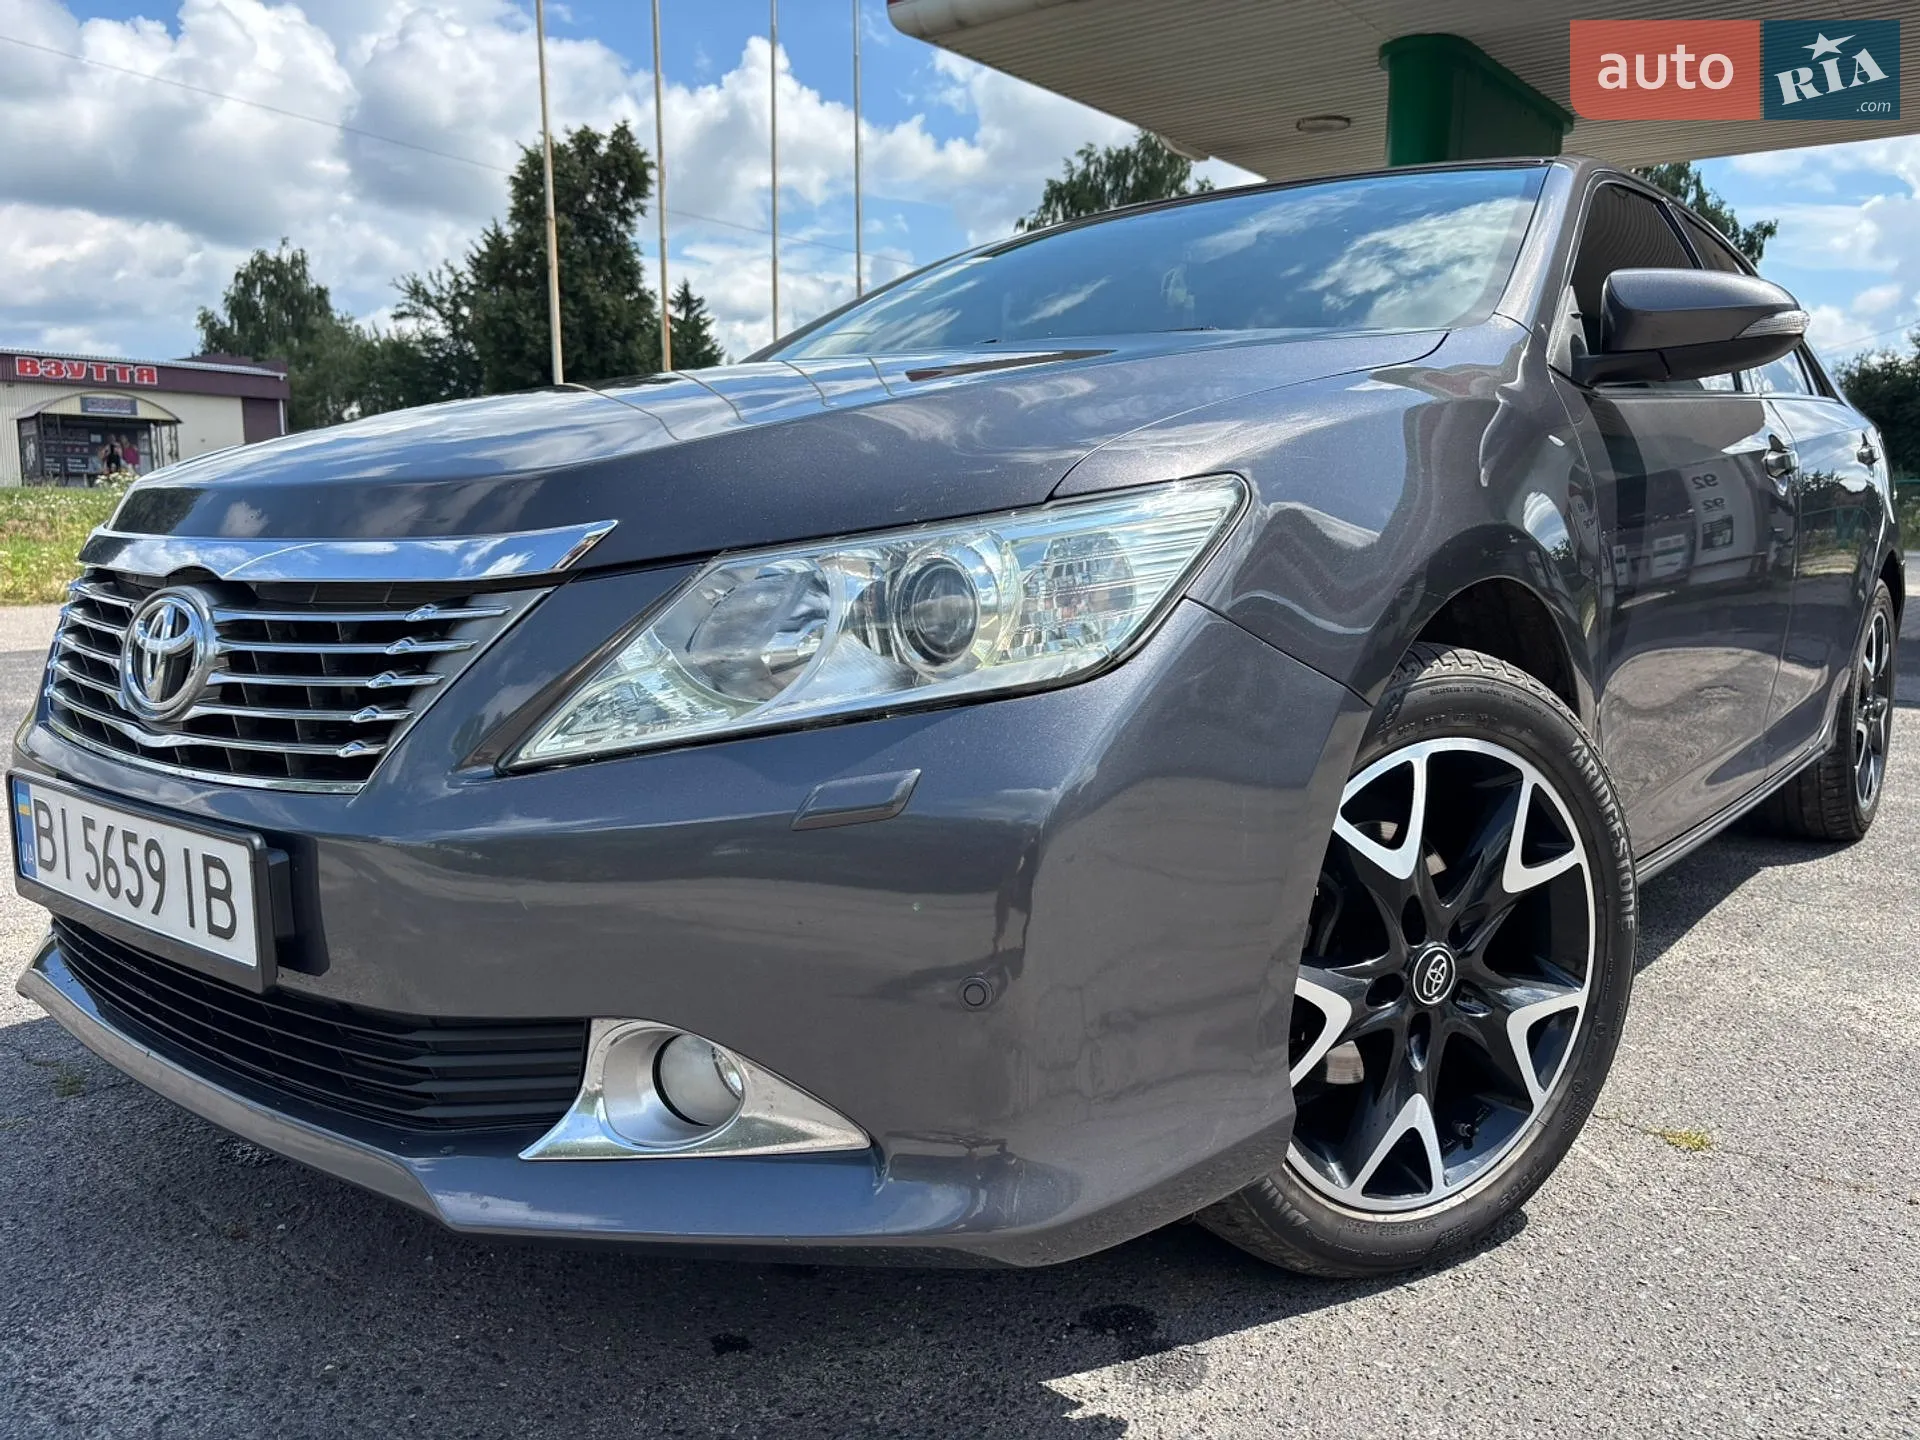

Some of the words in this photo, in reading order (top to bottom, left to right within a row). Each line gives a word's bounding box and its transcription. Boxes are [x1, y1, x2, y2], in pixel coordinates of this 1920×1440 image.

[15, 356, 159, 386] ВЗУТТЯ
[33, 798, 72, 881] BI
[82, 814, 167, 916] 5659
[183, 847, 237, 940] IB
[1567, 737, 1636, 930] BRIDGESTONE
